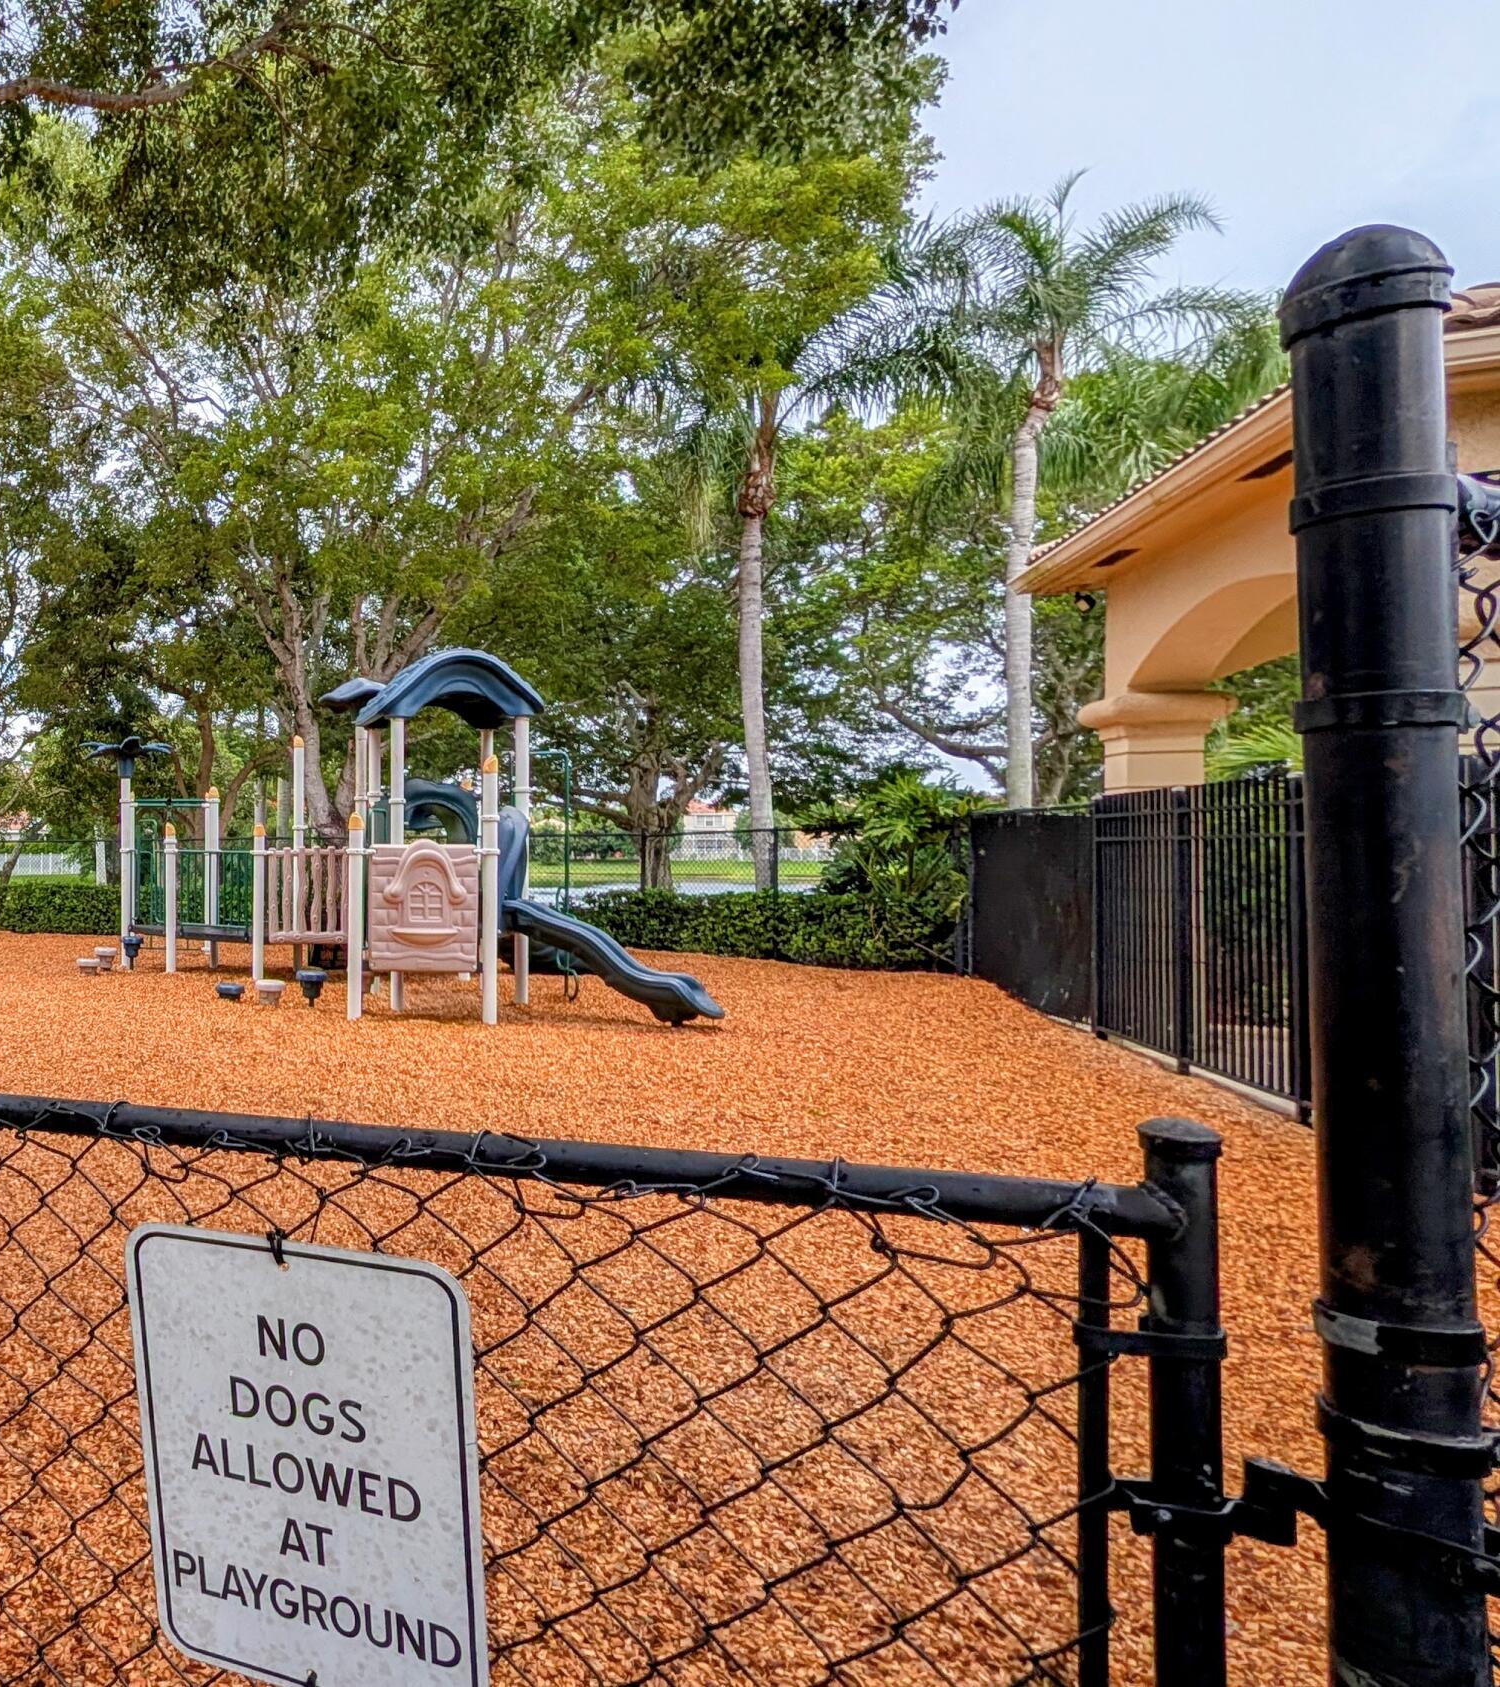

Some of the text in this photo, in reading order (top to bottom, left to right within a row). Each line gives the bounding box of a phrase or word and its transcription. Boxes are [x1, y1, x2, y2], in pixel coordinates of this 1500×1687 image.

[257, 1314, 326, 1366] NO
[229, 1375, 366, 1443] DOGS
[191, 1433, 421, 1522] ALLOWED
[279, 1518, 333, 1567] AT
[172, 1549, 462, 1668] PLAYGROUND
